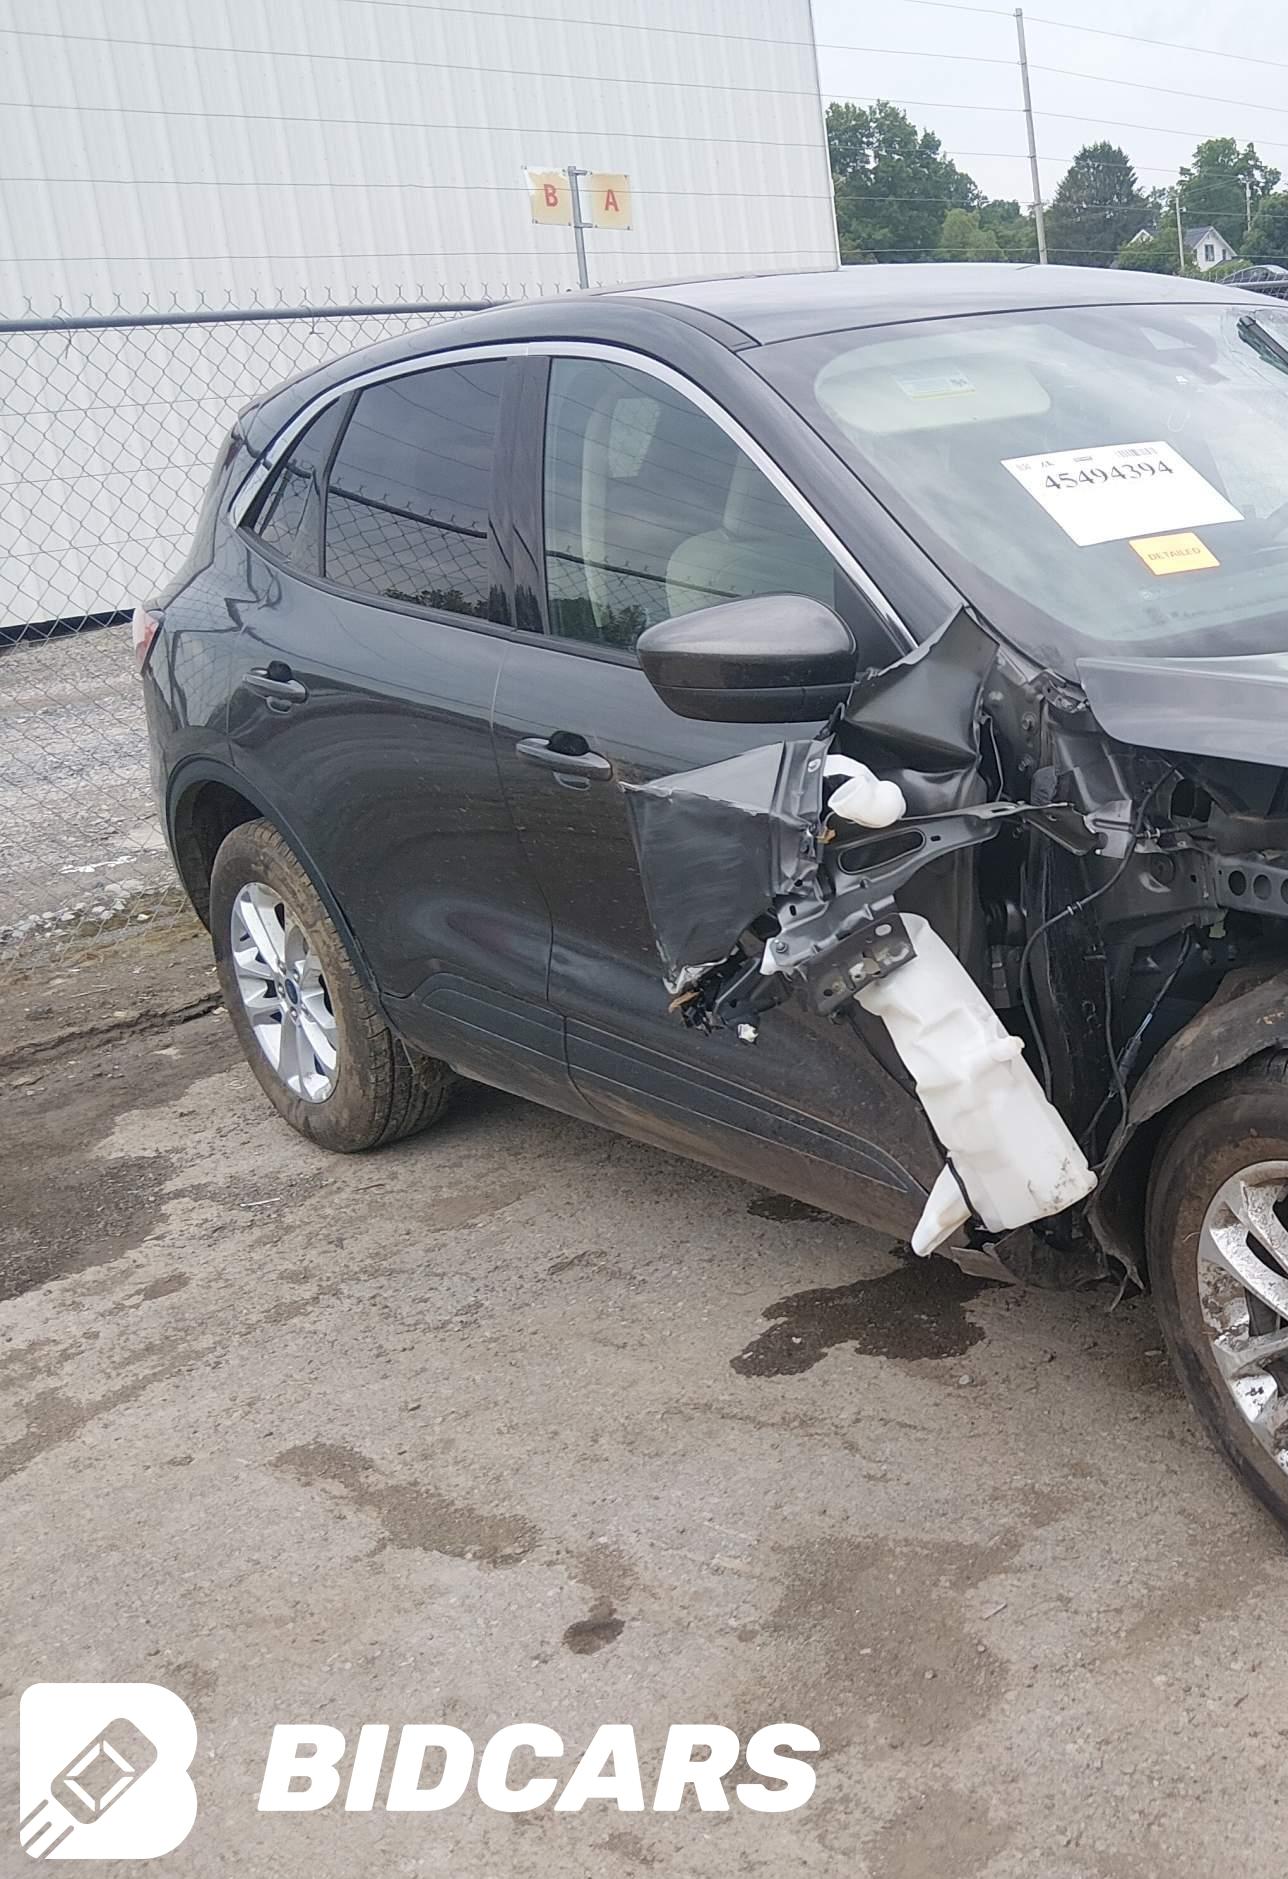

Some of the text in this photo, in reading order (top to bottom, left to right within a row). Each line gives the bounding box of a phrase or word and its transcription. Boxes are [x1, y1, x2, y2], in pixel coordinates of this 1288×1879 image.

[543, 183, 559, 207] B
[604, 189, 620, 212] A
[1045, 460, 1173, 489] 45494394
[1147, 546, 1202, 562] DETAILED
